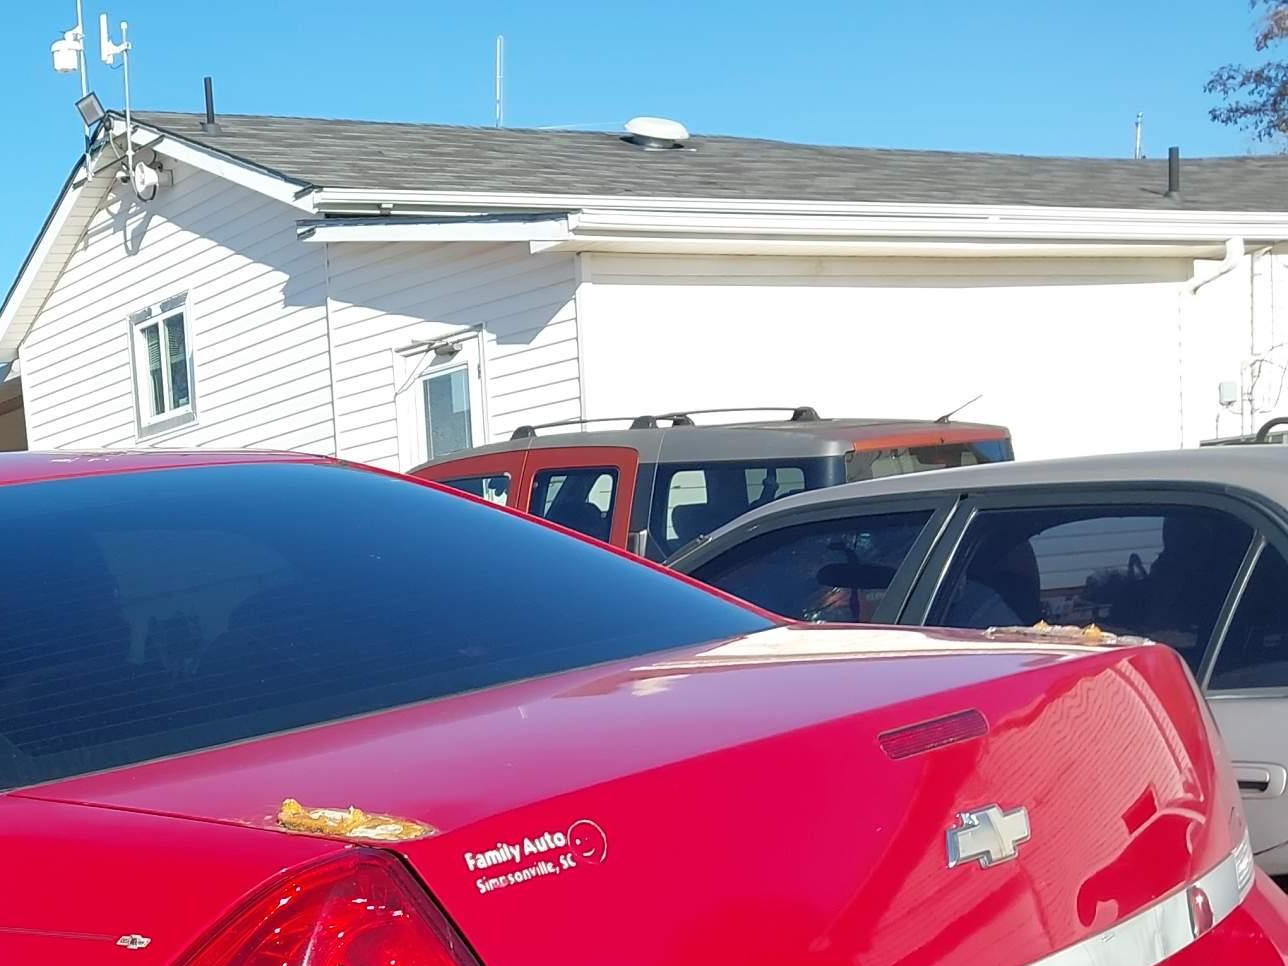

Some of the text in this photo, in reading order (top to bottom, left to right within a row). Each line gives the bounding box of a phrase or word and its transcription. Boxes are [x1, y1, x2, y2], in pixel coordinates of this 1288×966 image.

[464, 831, 566, 871] Family Auto
[559, 853, 577, 870] SC
